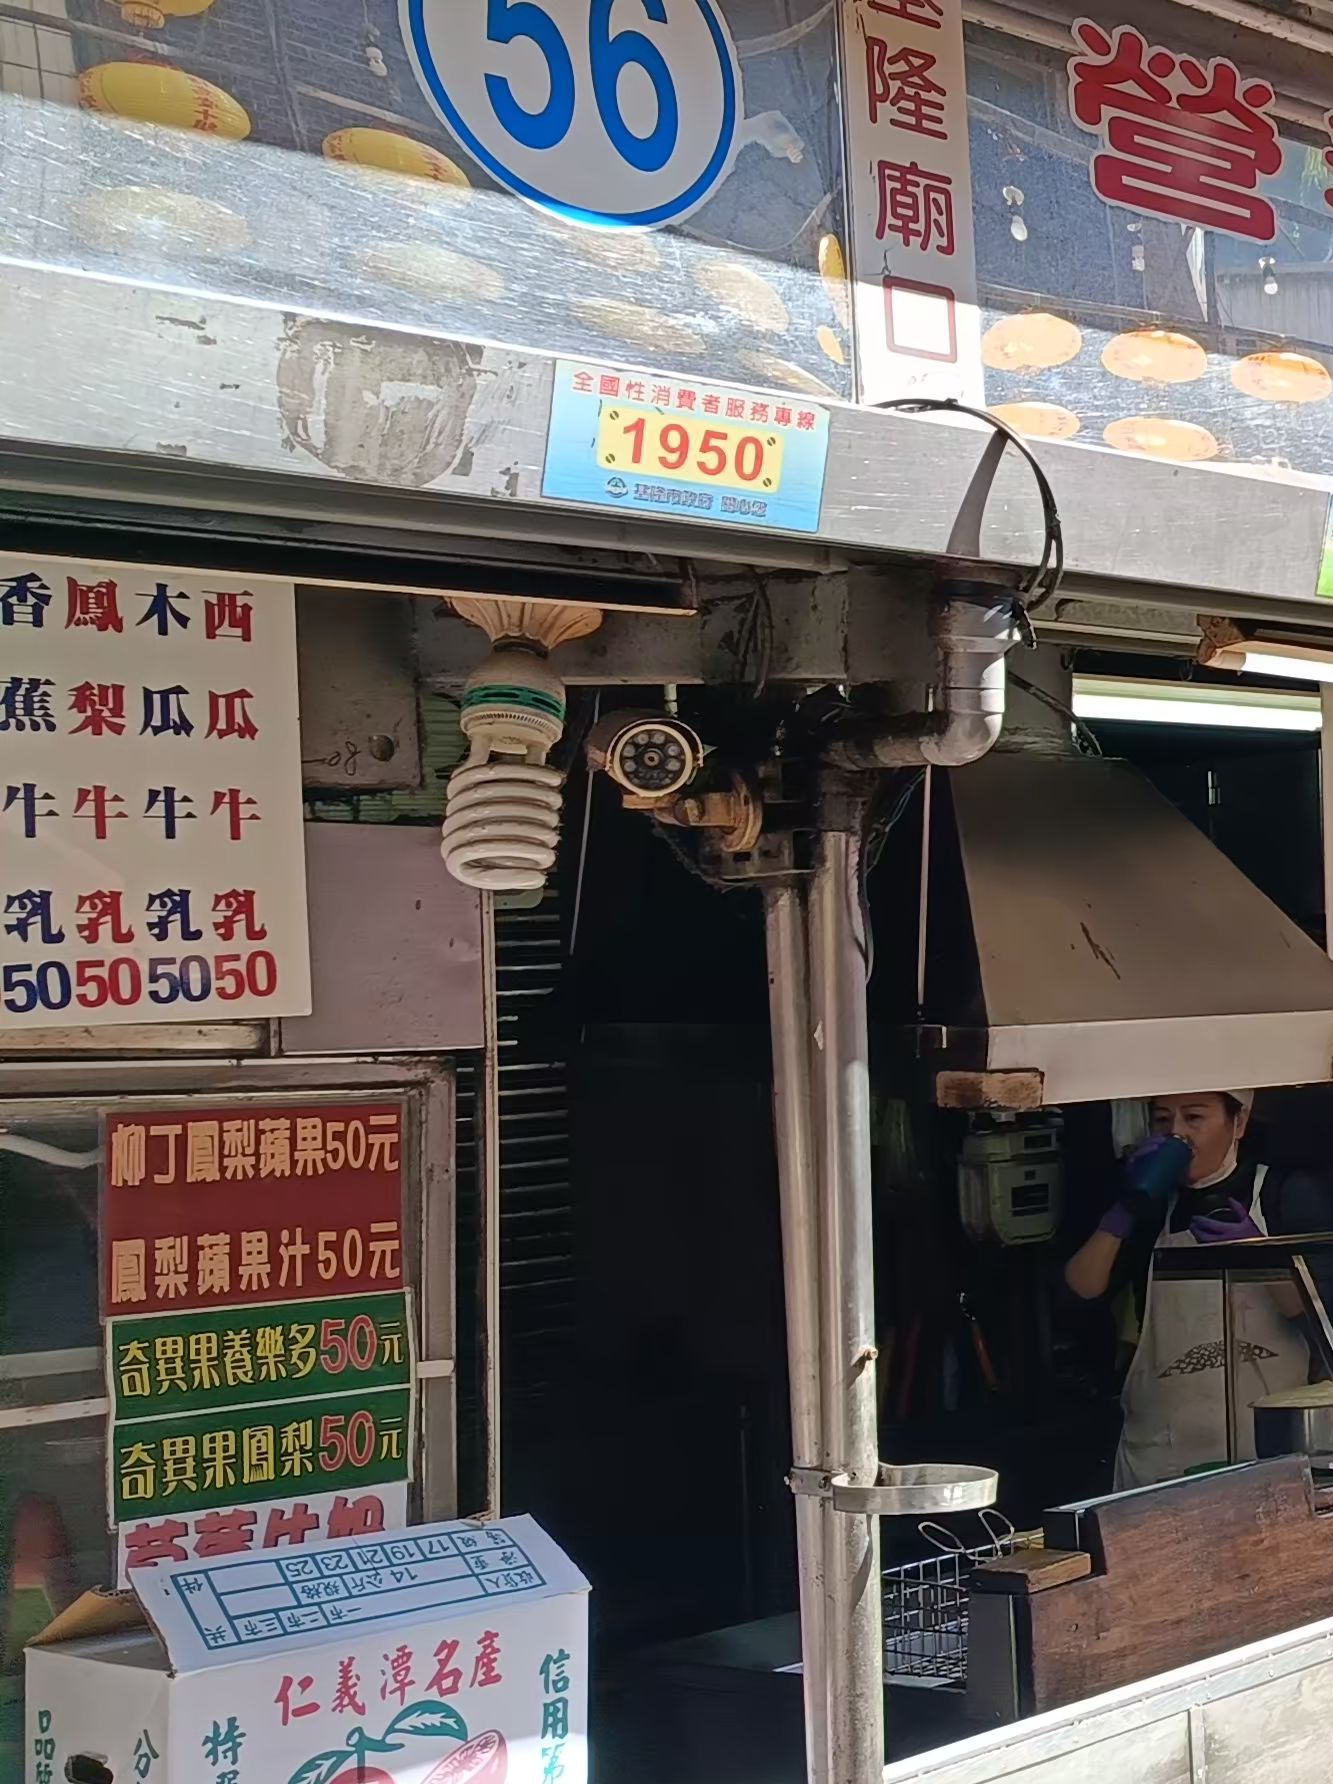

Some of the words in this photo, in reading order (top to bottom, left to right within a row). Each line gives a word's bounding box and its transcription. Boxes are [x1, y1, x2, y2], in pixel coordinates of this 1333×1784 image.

[484, 0, 679, 173] 56
[572, 370, 817, 431] 全國性消費者服務專線
[622, 417, 765, 482] 1950
[274, 1630, 503, 1726] 仁義潭名產
